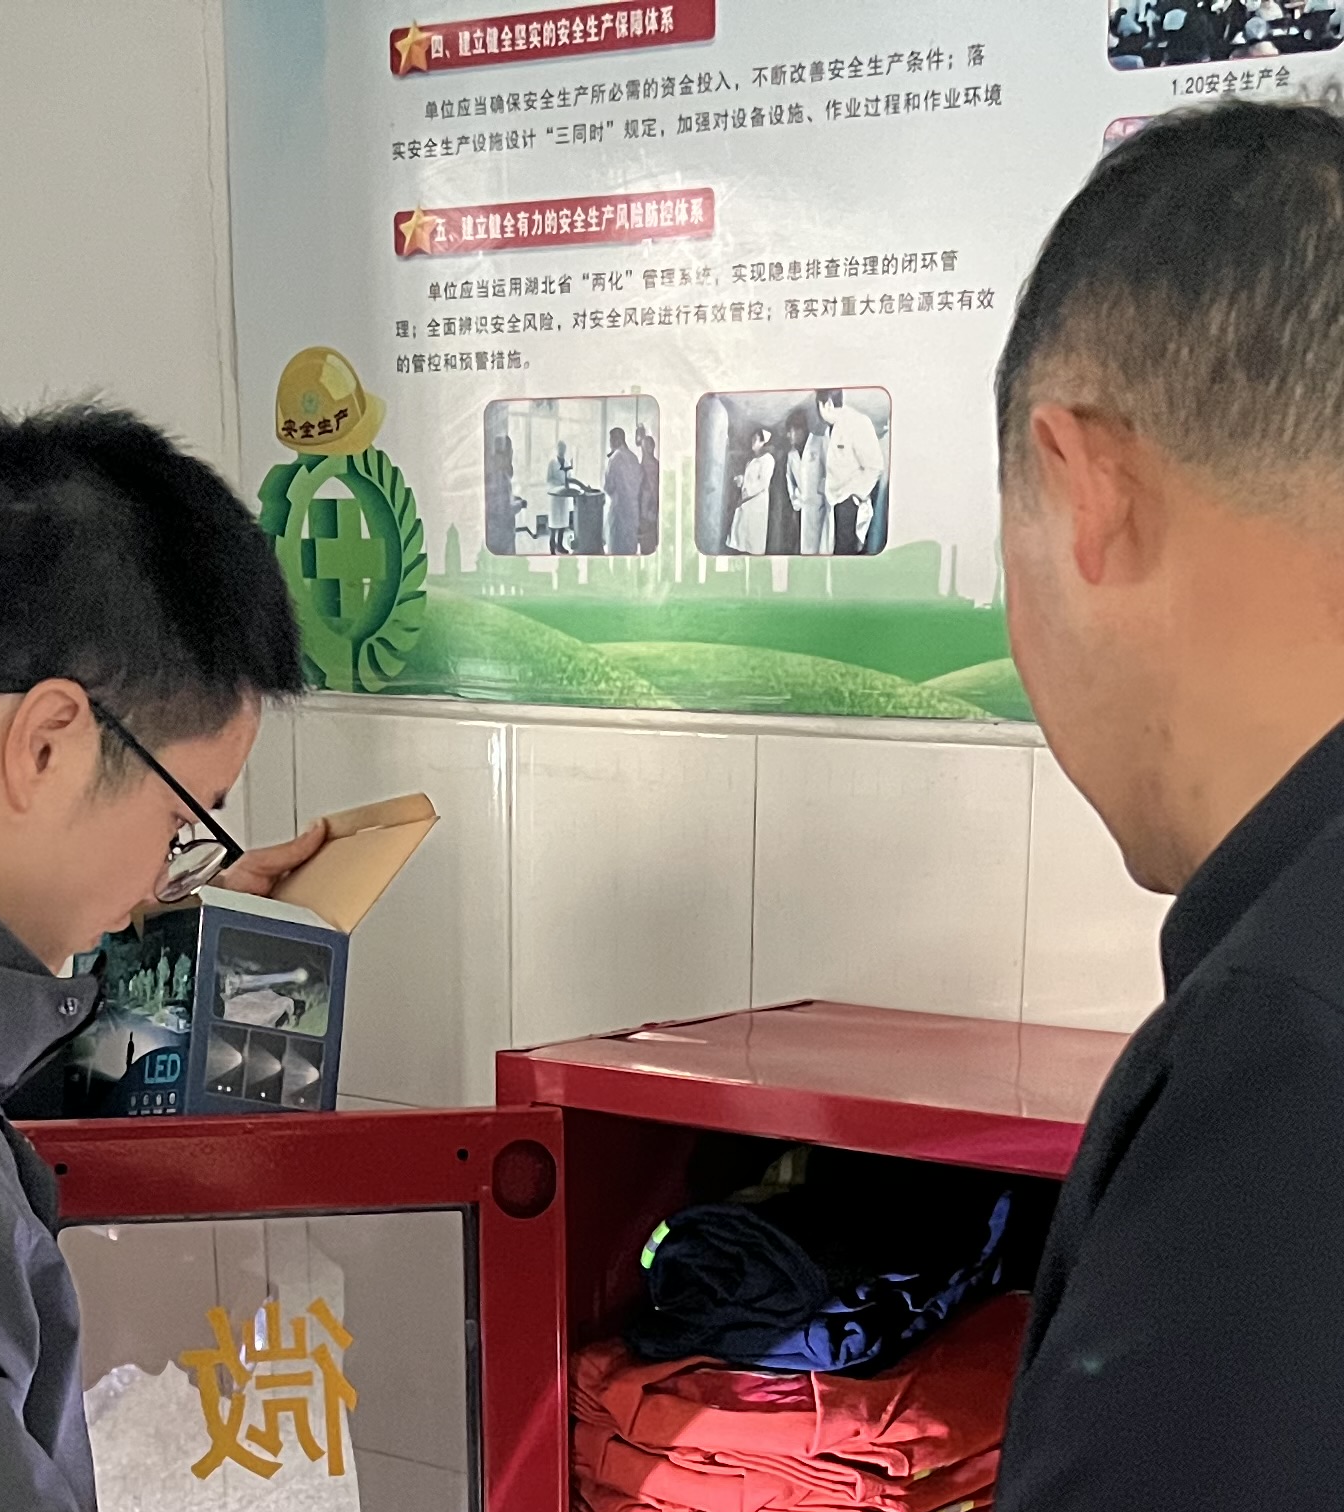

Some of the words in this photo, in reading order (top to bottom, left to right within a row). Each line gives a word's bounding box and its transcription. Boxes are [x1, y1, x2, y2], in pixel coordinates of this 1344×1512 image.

[1171, 65, 1291, 96] 1.20安全生产会
[433, 197, 704, 243] 五、建立健全有力的安全生产风险防控体系
[396, 350, 530, 374] 的管控和预警措施。
[281, 408, 349, 439] 安全生产
[144, 1053, 181, 1085] LED
